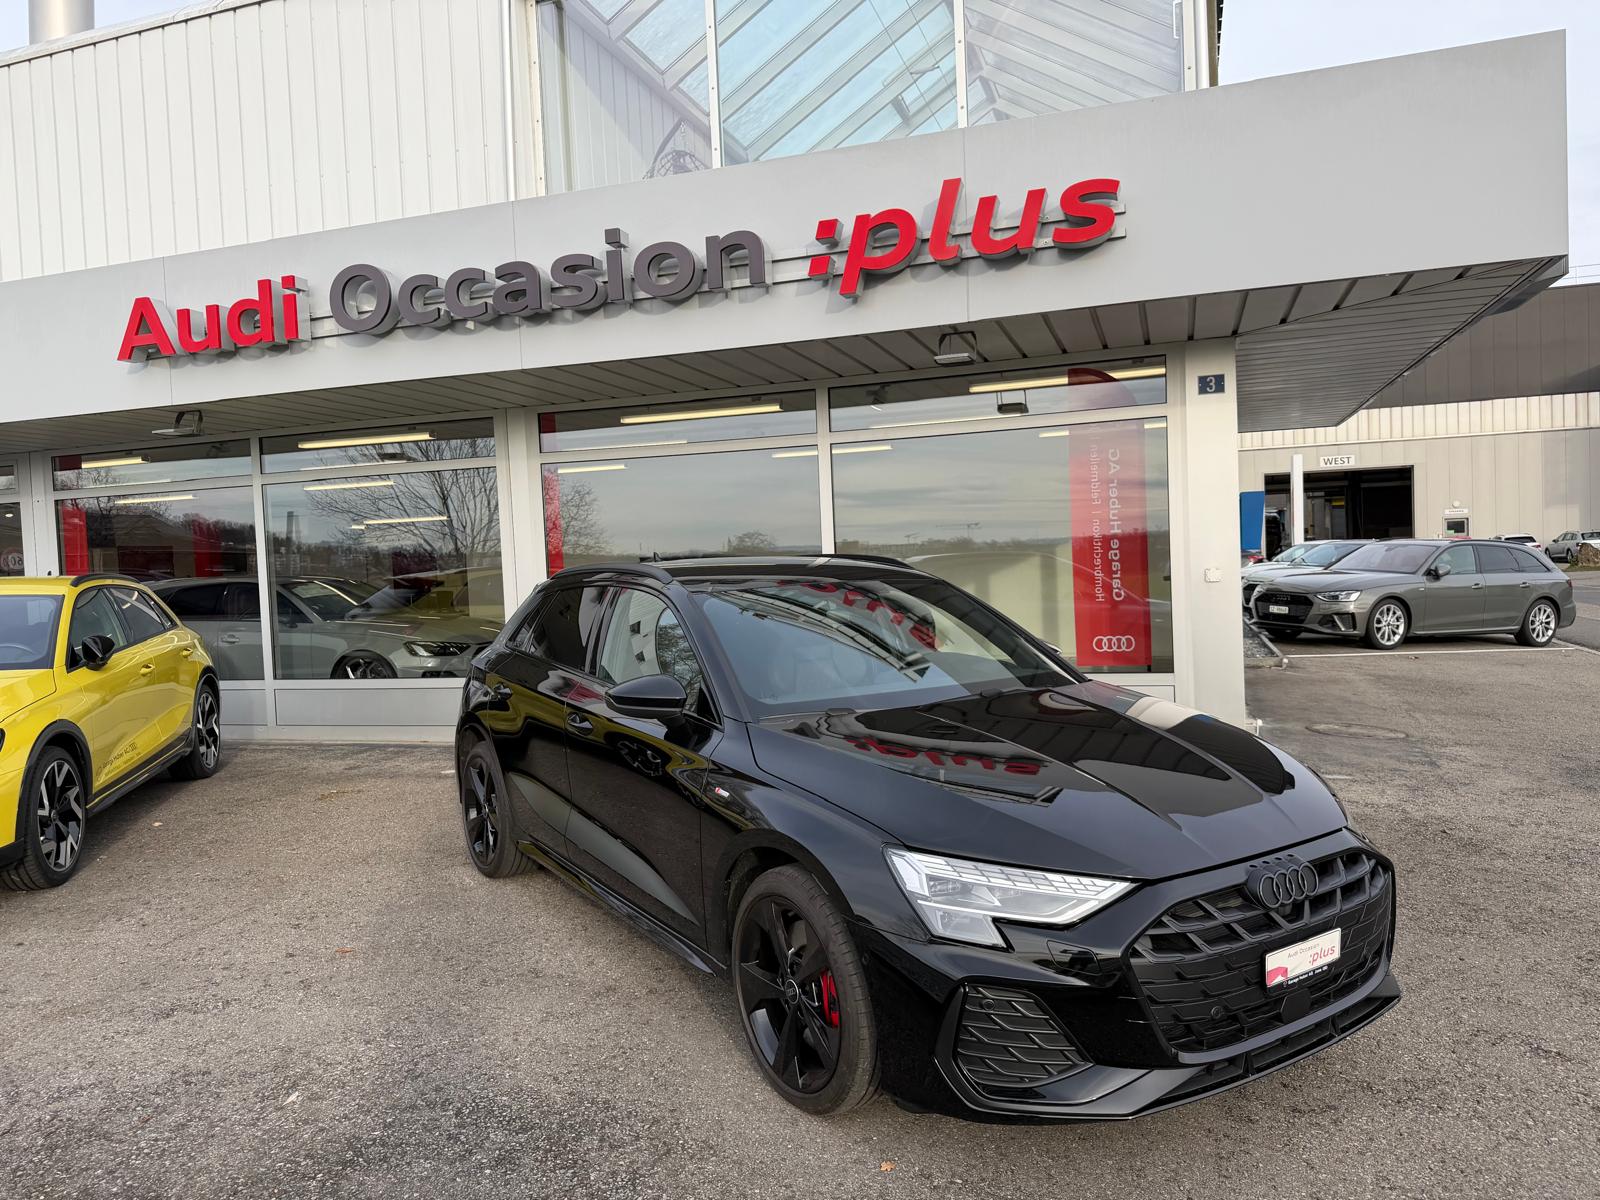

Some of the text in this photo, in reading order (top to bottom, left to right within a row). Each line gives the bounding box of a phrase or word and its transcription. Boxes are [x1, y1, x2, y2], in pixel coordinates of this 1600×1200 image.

[117, 177, 1121, 362] Audi Occasion :plus
[1206, 376, 1216, 393] 3
[1323, 456, 1352, 466] WEST
